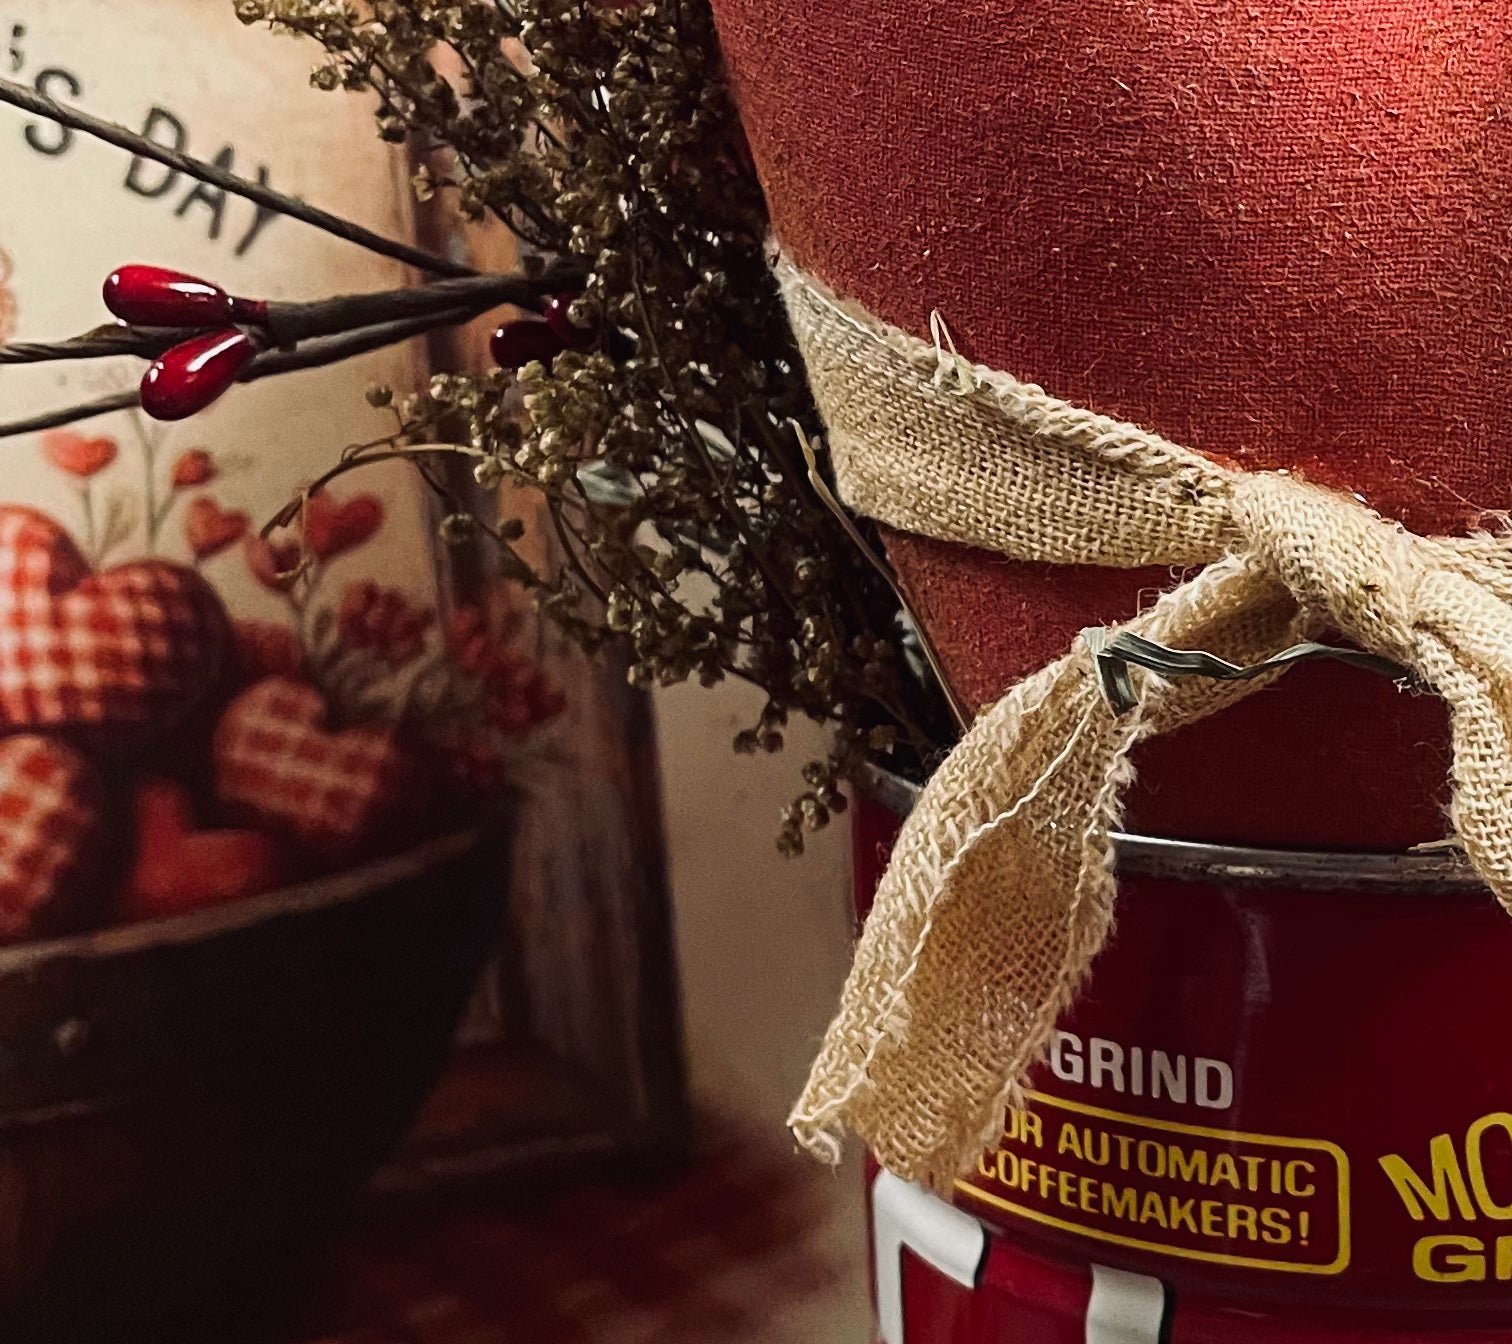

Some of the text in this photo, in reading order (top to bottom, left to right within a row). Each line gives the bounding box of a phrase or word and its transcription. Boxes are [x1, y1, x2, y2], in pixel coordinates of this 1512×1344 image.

[124, 105, 304, 258] DAY
[1049, 1029, 1234, 1111] GRIND
[977, 1149, 1311, 1248] COFFEEMAKERS!
[1002, 1102, 1317, 1198] OR AUTOMATIC
